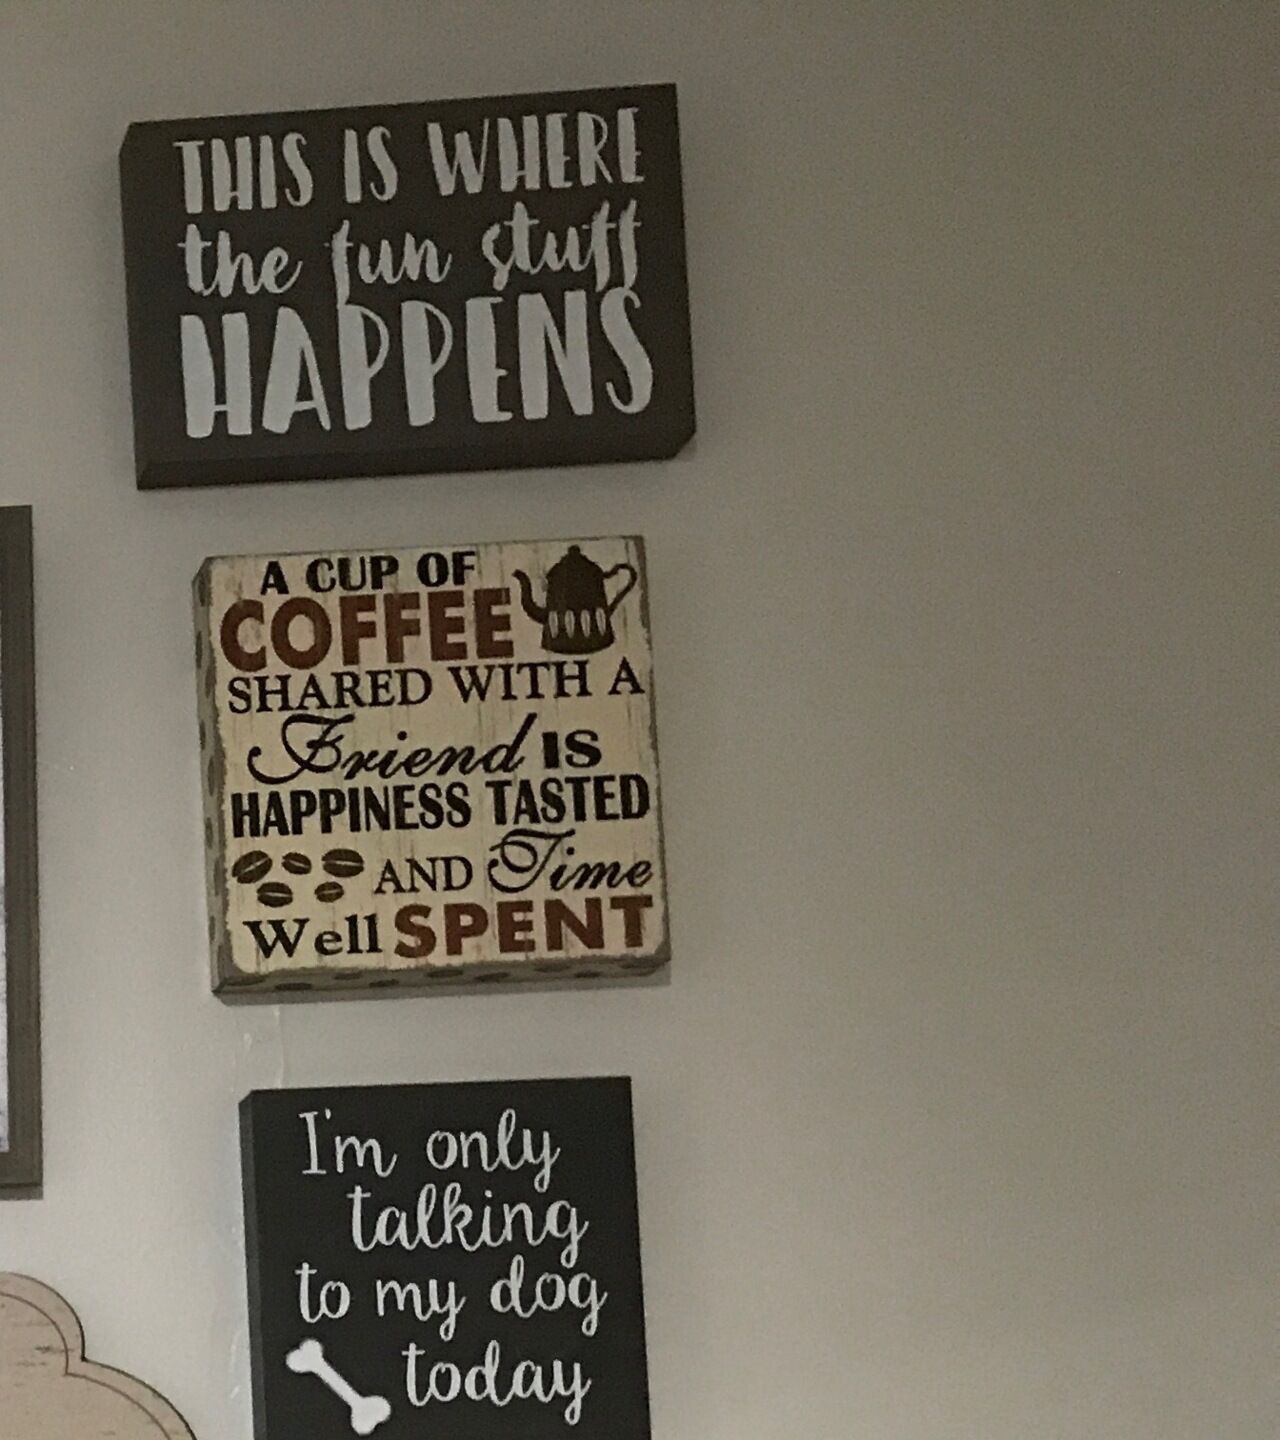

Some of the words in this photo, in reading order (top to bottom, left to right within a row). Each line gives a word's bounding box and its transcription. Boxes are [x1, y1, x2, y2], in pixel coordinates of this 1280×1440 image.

[172, 131, 313, 214] THIS
[343, 125, 398, 203] IS
[426, 107, 645, 196] WHERE
[177, 222, 302, 298] the
[323, 219, 452, 303] fun
[480, 199, 641, 291] stuff
[179, 286, 654, 438] HAPPENS
[260, 561, 289, 595] A
[306, 554, 399, 594] CUP
[416, 551, 476, 587] OF
[220, 587, 515, 672] COFFEE
[227, 667, 433, 714] SHARED
[448, 660, 589, 702] WITH
[609, 656, 645, 695] A
[247, 712, 538, 785] Friend
[543, 729, 602, 770] IS
[231, 782, 472, 838] HAPPINESS
[485, 773, 650, 826] TASTED
[374, 856, 473, 895] AND
[487, 828, 654, 893] Time
[243, 913, 383, 960] Well
[393, 895, 654, 959] SPENT
[298, 1108, 398, 1178] I'm
[426, 1108, 561, 1193] only
[346, 1182, 590, 1269] talking
[295, 1262, 351, 1323] to
[376, 1278, 467, 1342] my
[490, 1254, 608, 1337] dog
[401, 1339, 593, 1426] today
